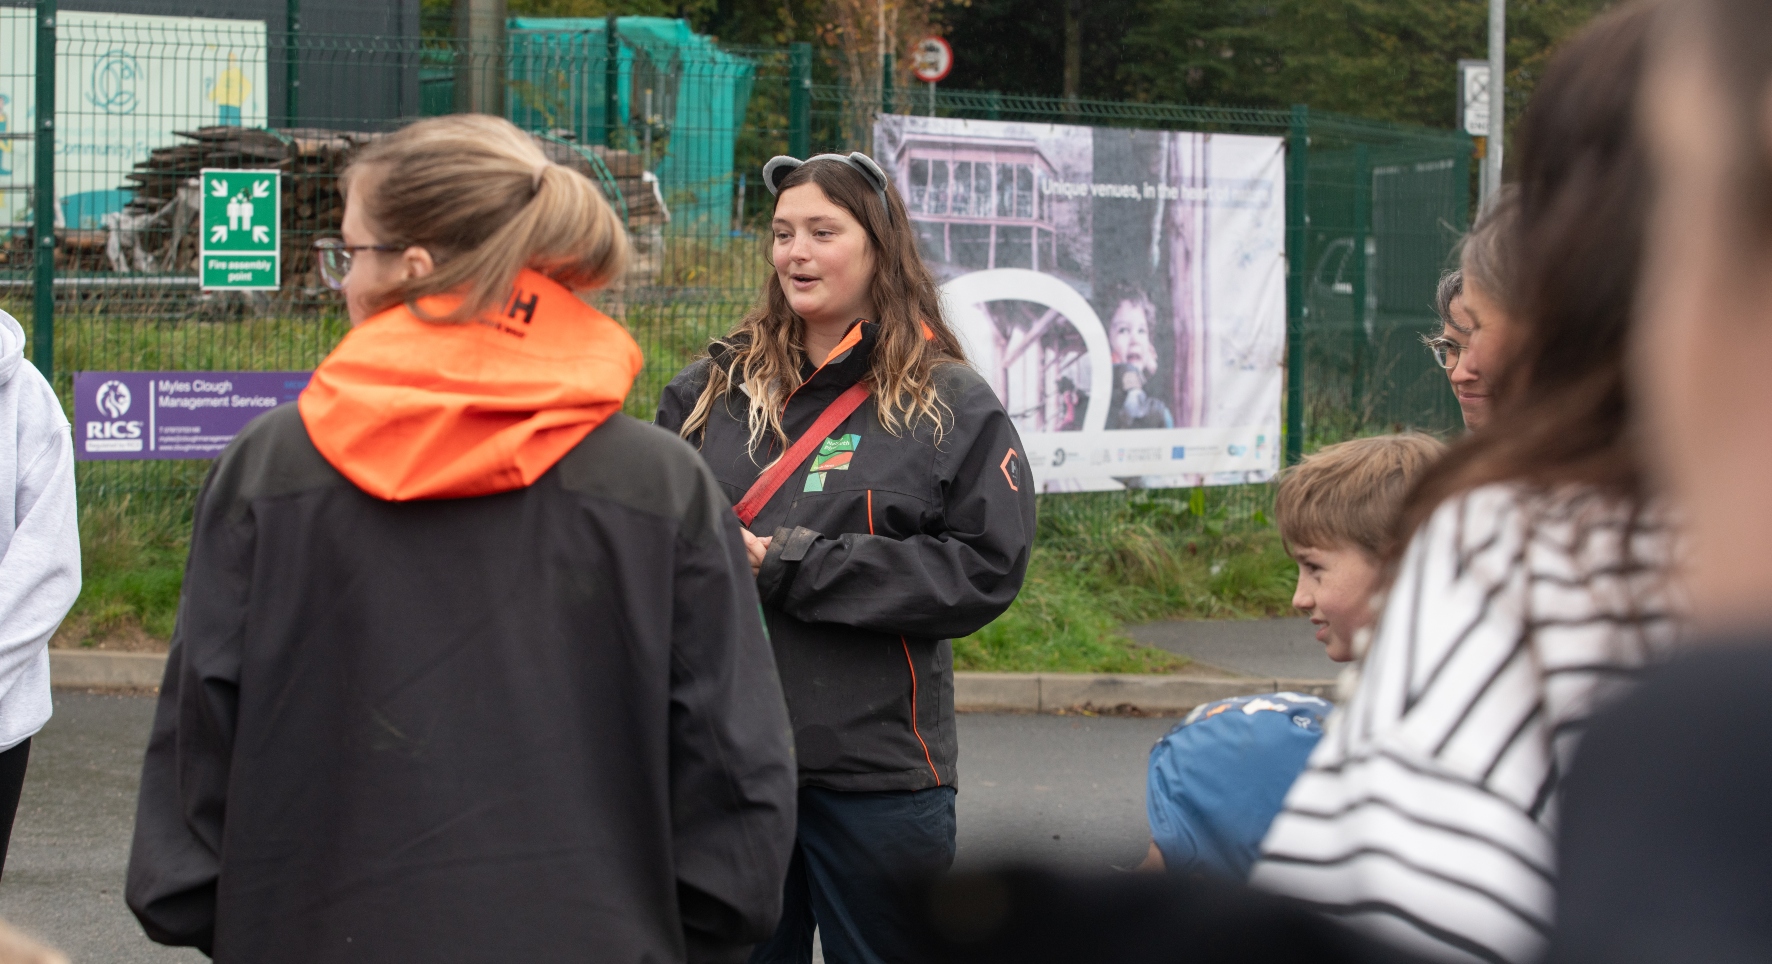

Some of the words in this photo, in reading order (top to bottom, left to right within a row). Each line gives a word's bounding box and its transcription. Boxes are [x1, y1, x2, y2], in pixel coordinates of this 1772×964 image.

[1042, 179, 1087, 199] Unique
[1091, 182, 1141, 201] venues,
[1143, 181, 1156, 199] in
[1158, 182, 1178, 199] the
[208, 259, 227, 270] Fire
[228, 259, 272, 272] assembly
[227, 271, 253, 283] point
[158, 379, 191, 394] Myles
[192, 379, 233, 394] Clough
[158, 395, 230, 410] Management
[231, 395, 277, 408] Services
[86, 420, 142, 439] RICS
